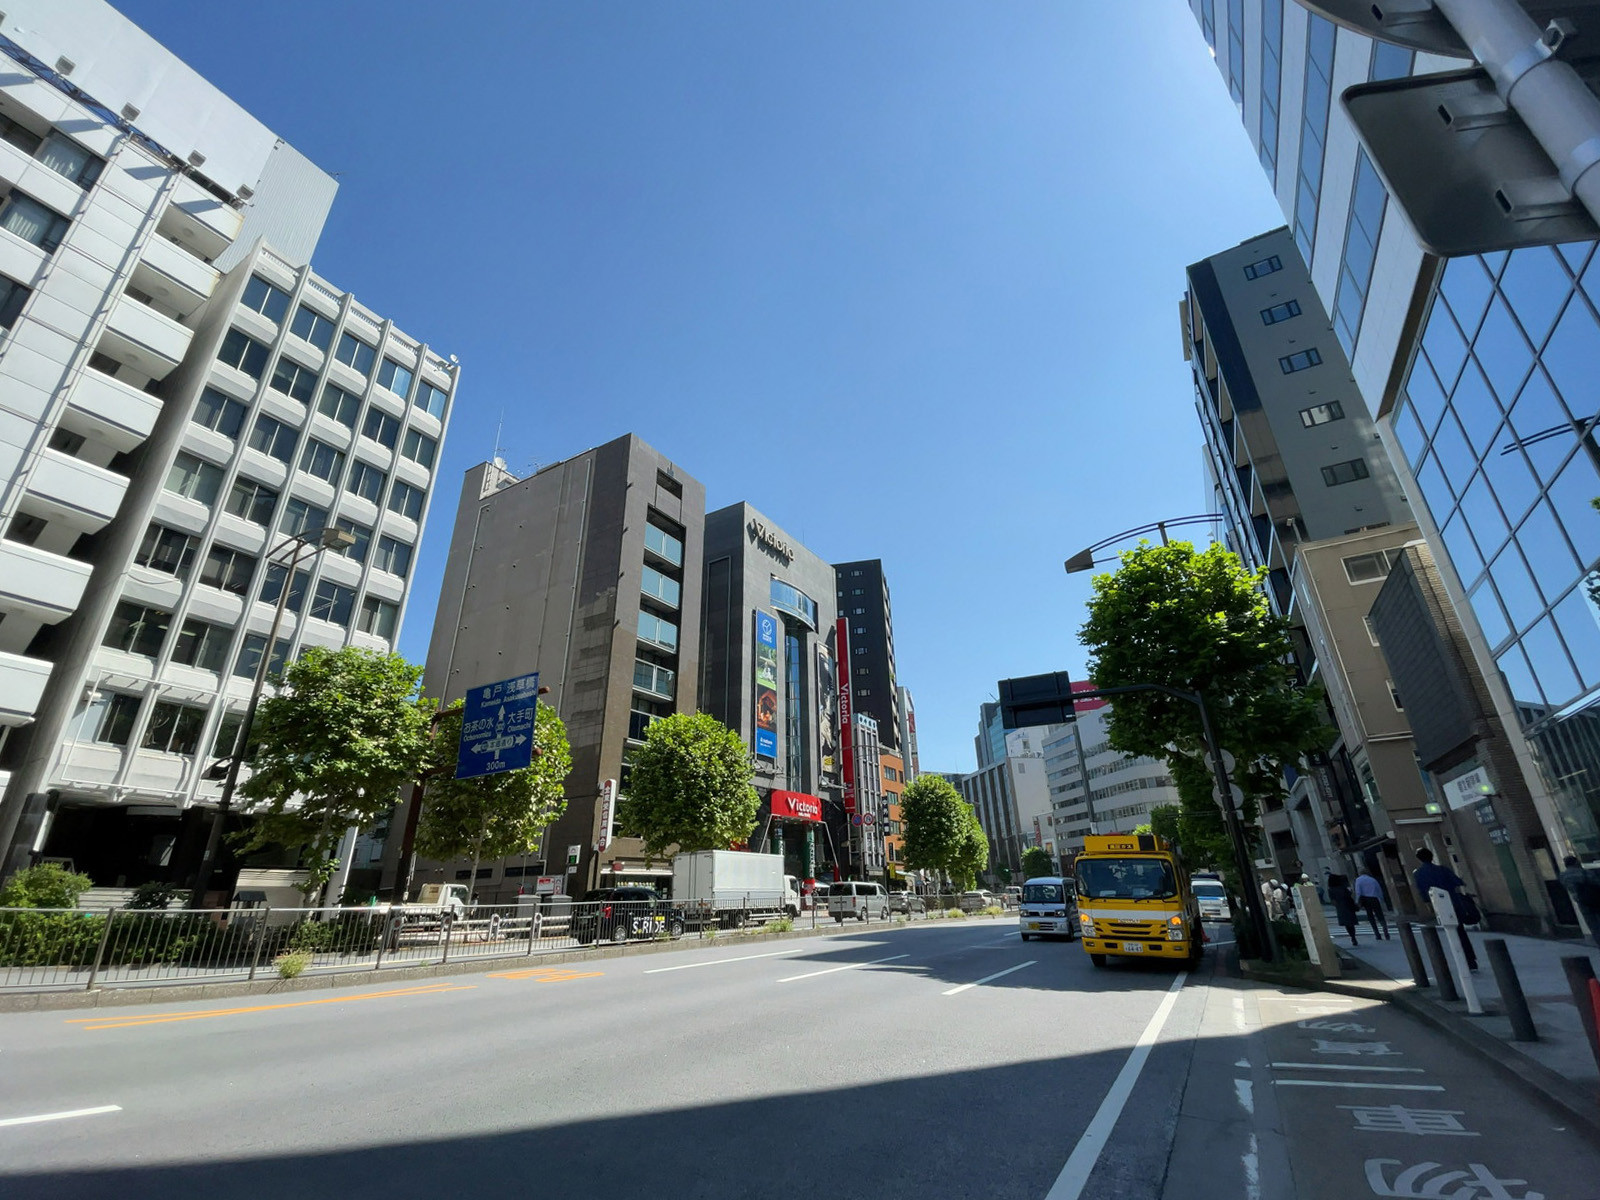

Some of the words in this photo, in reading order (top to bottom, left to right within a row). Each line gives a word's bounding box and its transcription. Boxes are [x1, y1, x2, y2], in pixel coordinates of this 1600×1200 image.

[757, 522, 795, 562] Victoria
[483, 684, 502, 699] 亀戸
[840, 683, 850, 724] Victoria
[508, 708, 534, 724] 大手町
[463, 717, 495, 734] お茶の水
[486, 761, 506, 771] 300m
[787, 796, 819, 814] Victoria
